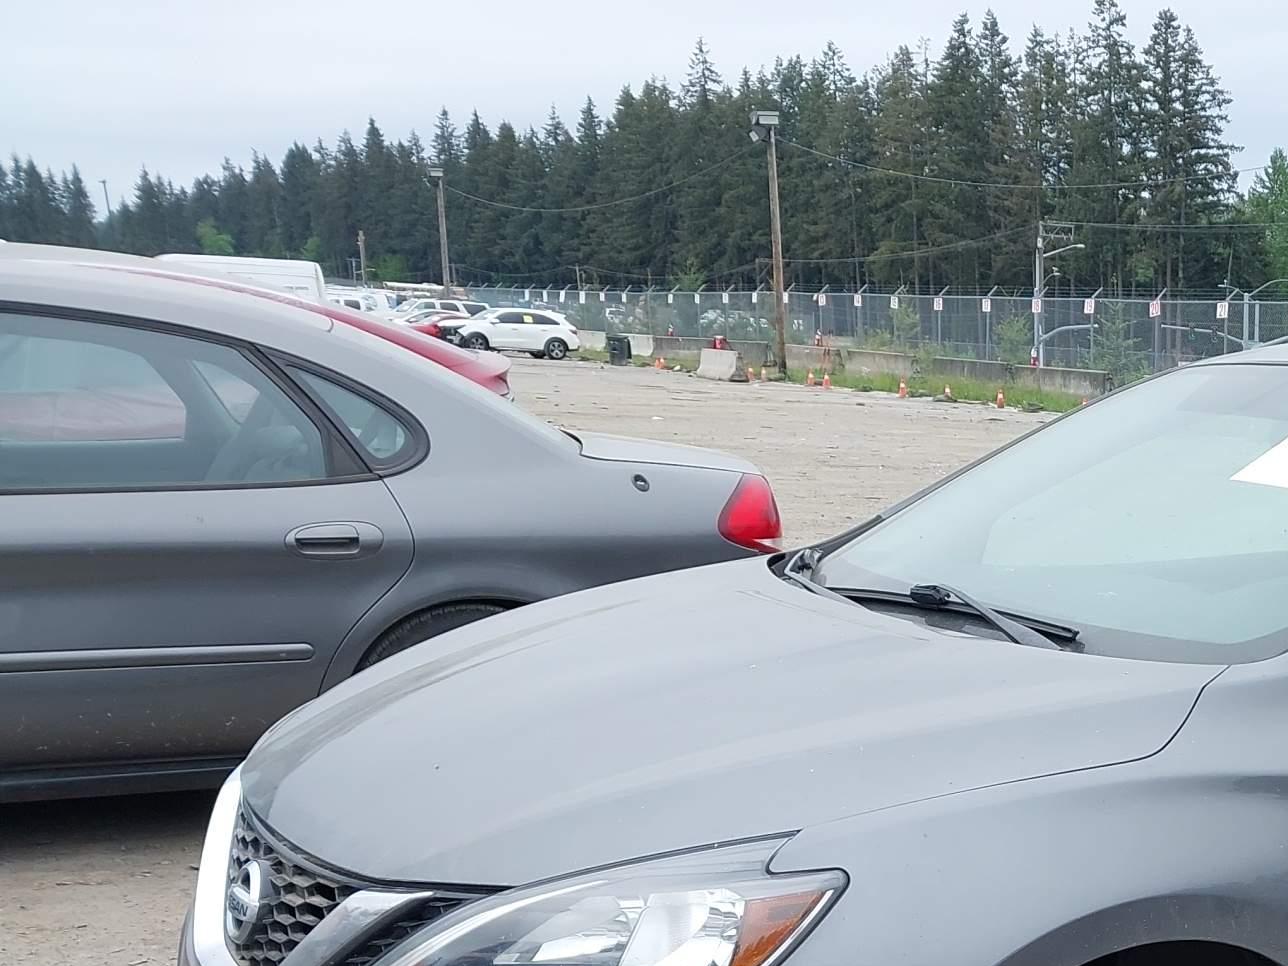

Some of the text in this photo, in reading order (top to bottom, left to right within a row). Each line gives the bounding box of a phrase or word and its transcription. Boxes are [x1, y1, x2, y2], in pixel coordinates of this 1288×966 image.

[1033, 300, 1041, 312] 18
[1085, 300, 1094, 312] 19
[1151, 302, 1160, 315] 20
[1219, 303, 1227, 316] 21
